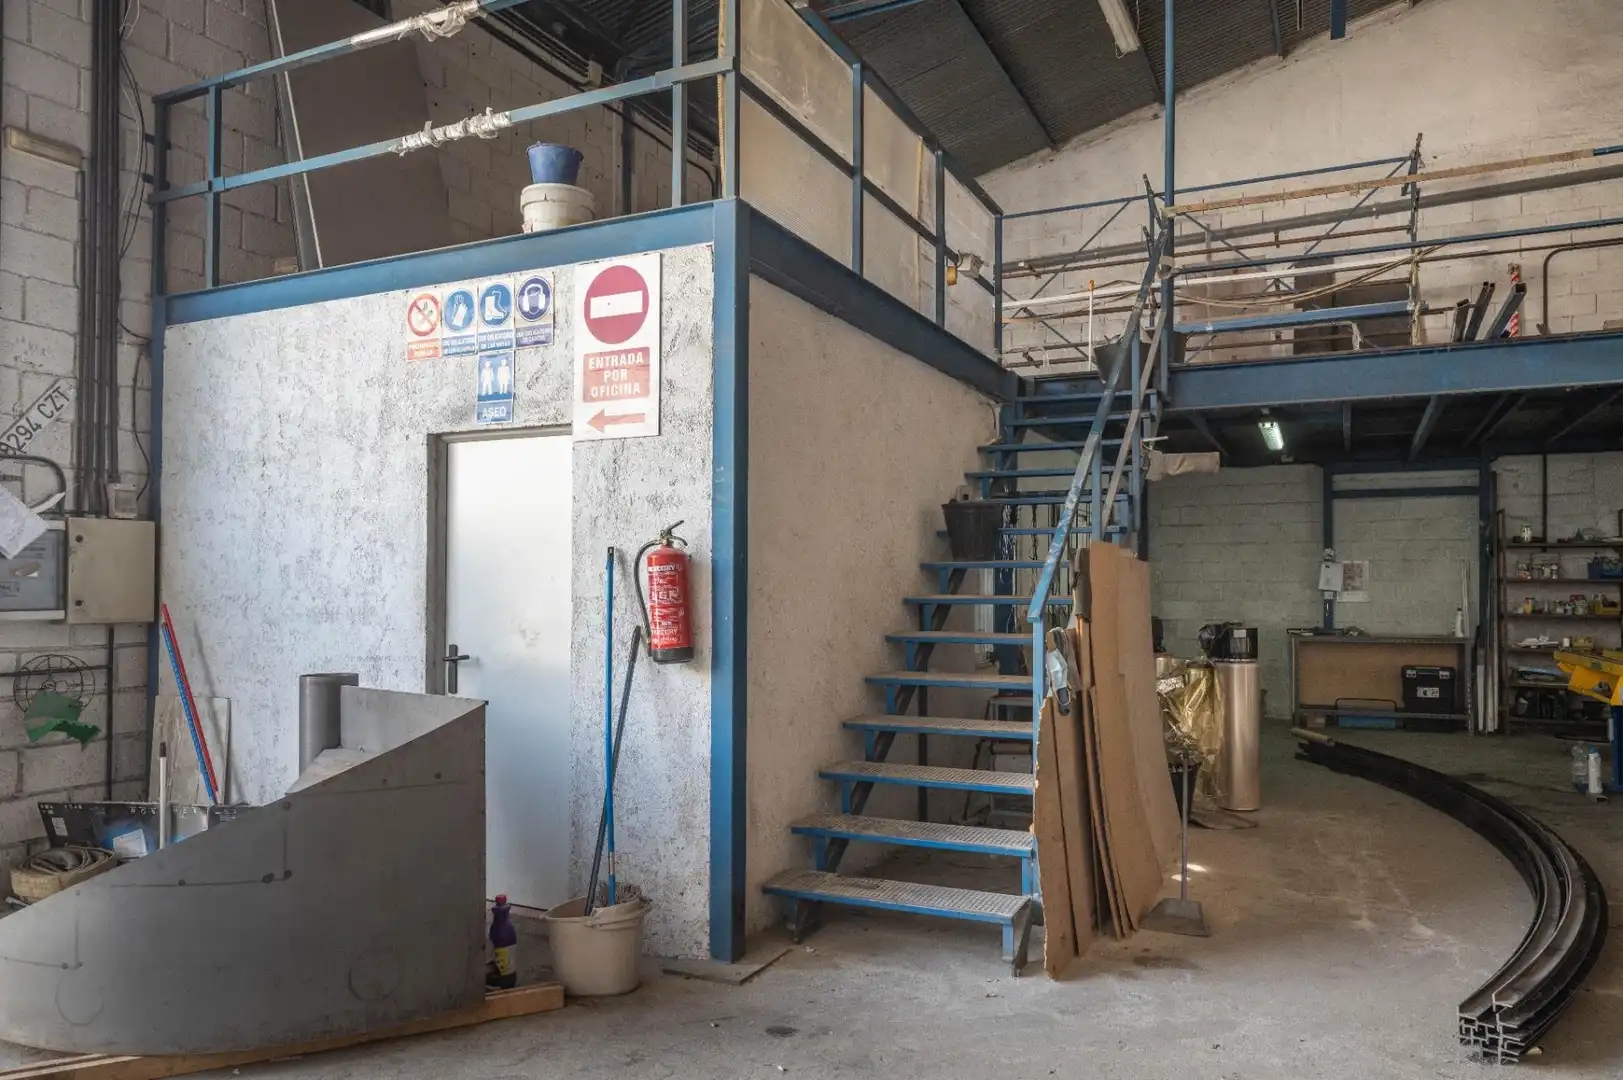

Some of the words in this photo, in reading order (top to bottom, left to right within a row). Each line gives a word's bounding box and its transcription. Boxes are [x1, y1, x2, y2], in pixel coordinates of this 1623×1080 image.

[588, 352, 644, 370] ENTRADA
[603, 368, 628, 383] POR
[590, 382, 641, 399] OFICINA
[37, 386, 70, 419] CZT
[482, 406, 507, 419] ASEO
